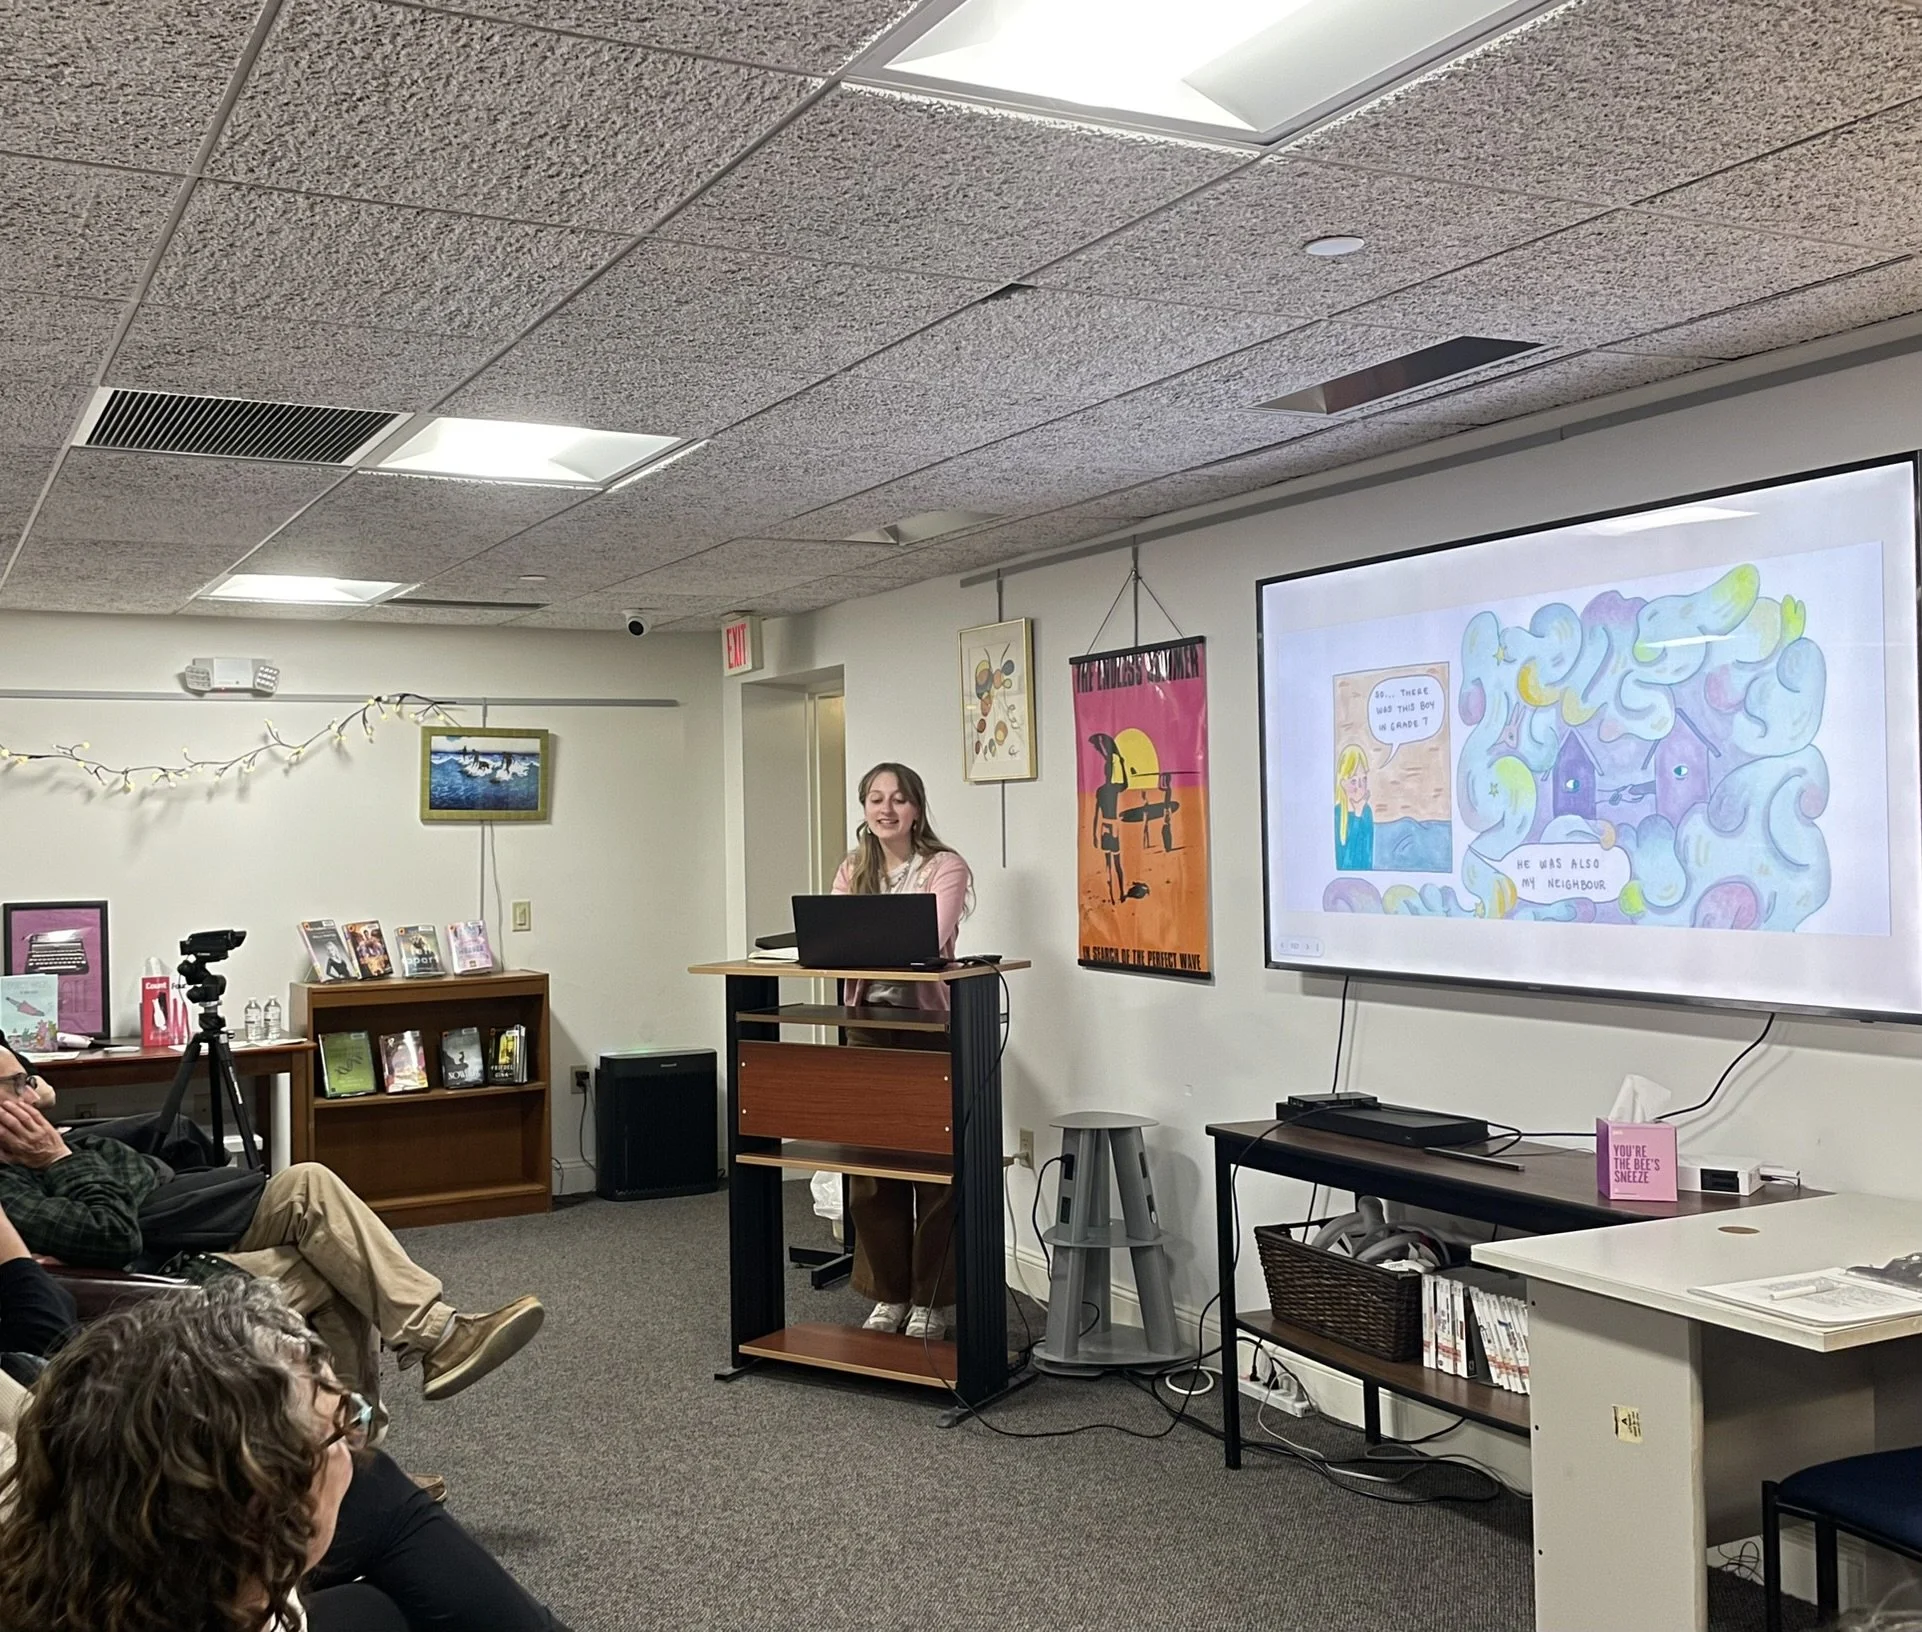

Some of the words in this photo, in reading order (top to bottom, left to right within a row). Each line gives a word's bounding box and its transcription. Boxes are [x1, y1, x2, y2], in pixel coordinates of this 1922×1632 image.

[726, 623, 747, 669] EXIT
[1097, 652, 1142, 691] ENDLESS
[1400, 687, 1429, 697] THERE
[1376, 705, 1392, 715] WAS
[1397, 703, 1415, 713] THIS
[1420, 701, 1435, 711] BOY
[1379, 723, 1387, 731] IN
[1390, 720, 1419, 731] GRADE
[1422, 716, 1428, 726] 7
[1517, 860, 1530, 869] HE
[1539, 858, 1562, 869] WAS
[1571, 859, 1600, 869] ALSO
[1522, 877, 1535, 890] MY
[1548, 879, 1606, 890] NEIGHBOUR
[1082, 946, 1091, 960] IN
[1092, 946, 1119, 963] SEARCH
[1121, 948, 1130, 963] OF
[1132, 950, 1145, 966] THE
[1147, 951, 1177, 968] PERFECT
[1179, 953, 1201, 970] WAVE
[1613, 1145, 1647, 1158] YOU'RE
[1614, 1157, 1631, 1170] THE
[1634, 1158, 1660, 1171] BEE'S
[1614, 1170, 1650, 1184] SNEEZE
